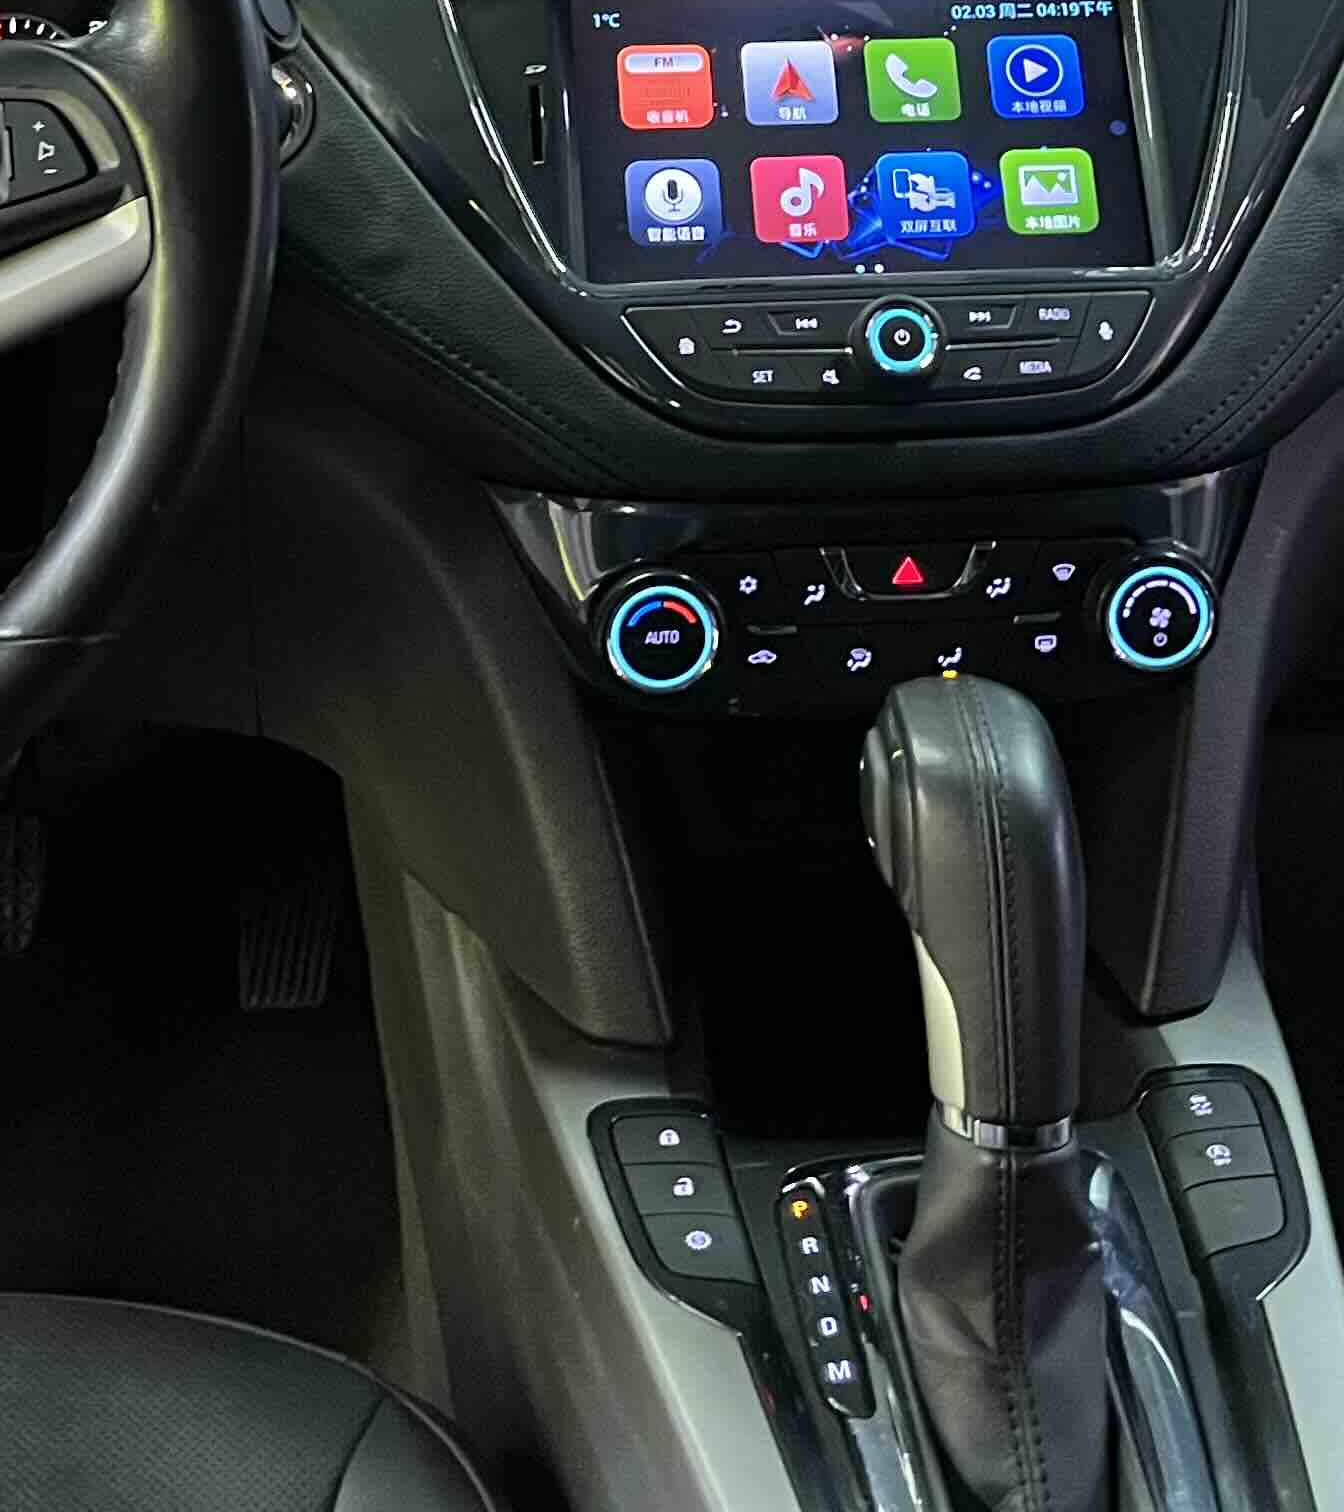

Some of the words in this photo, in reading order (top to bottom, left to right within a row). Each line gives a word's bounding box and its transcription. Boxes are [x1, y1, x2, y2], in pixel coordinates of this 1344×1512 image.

[950, 4, 996, 20] 02.03
[999, 3, 1034, 19] 周二
[654, 56, 674, 68] FM
[778, 106, 807, 121] 导航
[901, 103, 931, 117] 电话
[1011, 99, 1068, 113] 本地视频
[789, 223, 817, 237] 音乐
[900, 219, 957, 233] 双屏互联
[1024, 215, 1080, 230] 本地图片
[1038, 306, 1071, 320] RADIO
[752, 368, 774, 384] SET
[644, 628, 681, 645] AUTO
[791, 1199, 809, 1219] P
[801, 1236, 820, 1255] R
[811, 1274, 831, 1295] N
[819, 1316, 839, 1337] D
[827, 1359, 853, 1382] M
